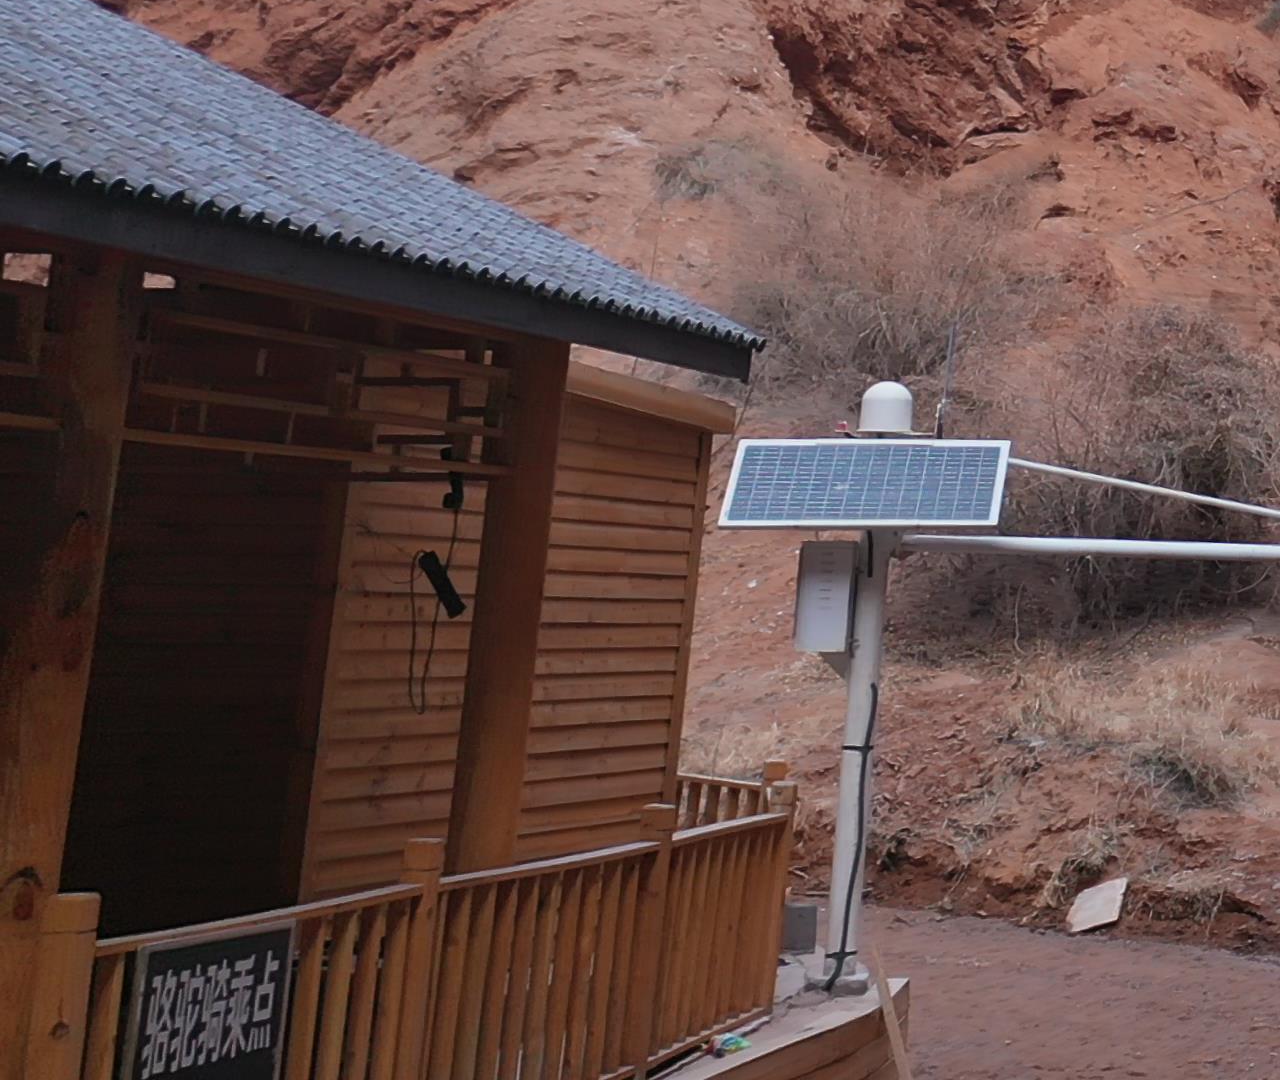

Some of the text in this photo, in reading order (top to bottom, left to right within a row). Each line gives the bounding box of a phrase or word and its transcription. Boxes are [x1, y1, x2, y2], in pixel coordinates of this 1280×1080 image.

[141, 950, 280, 1080] 骆驼骑乘点
